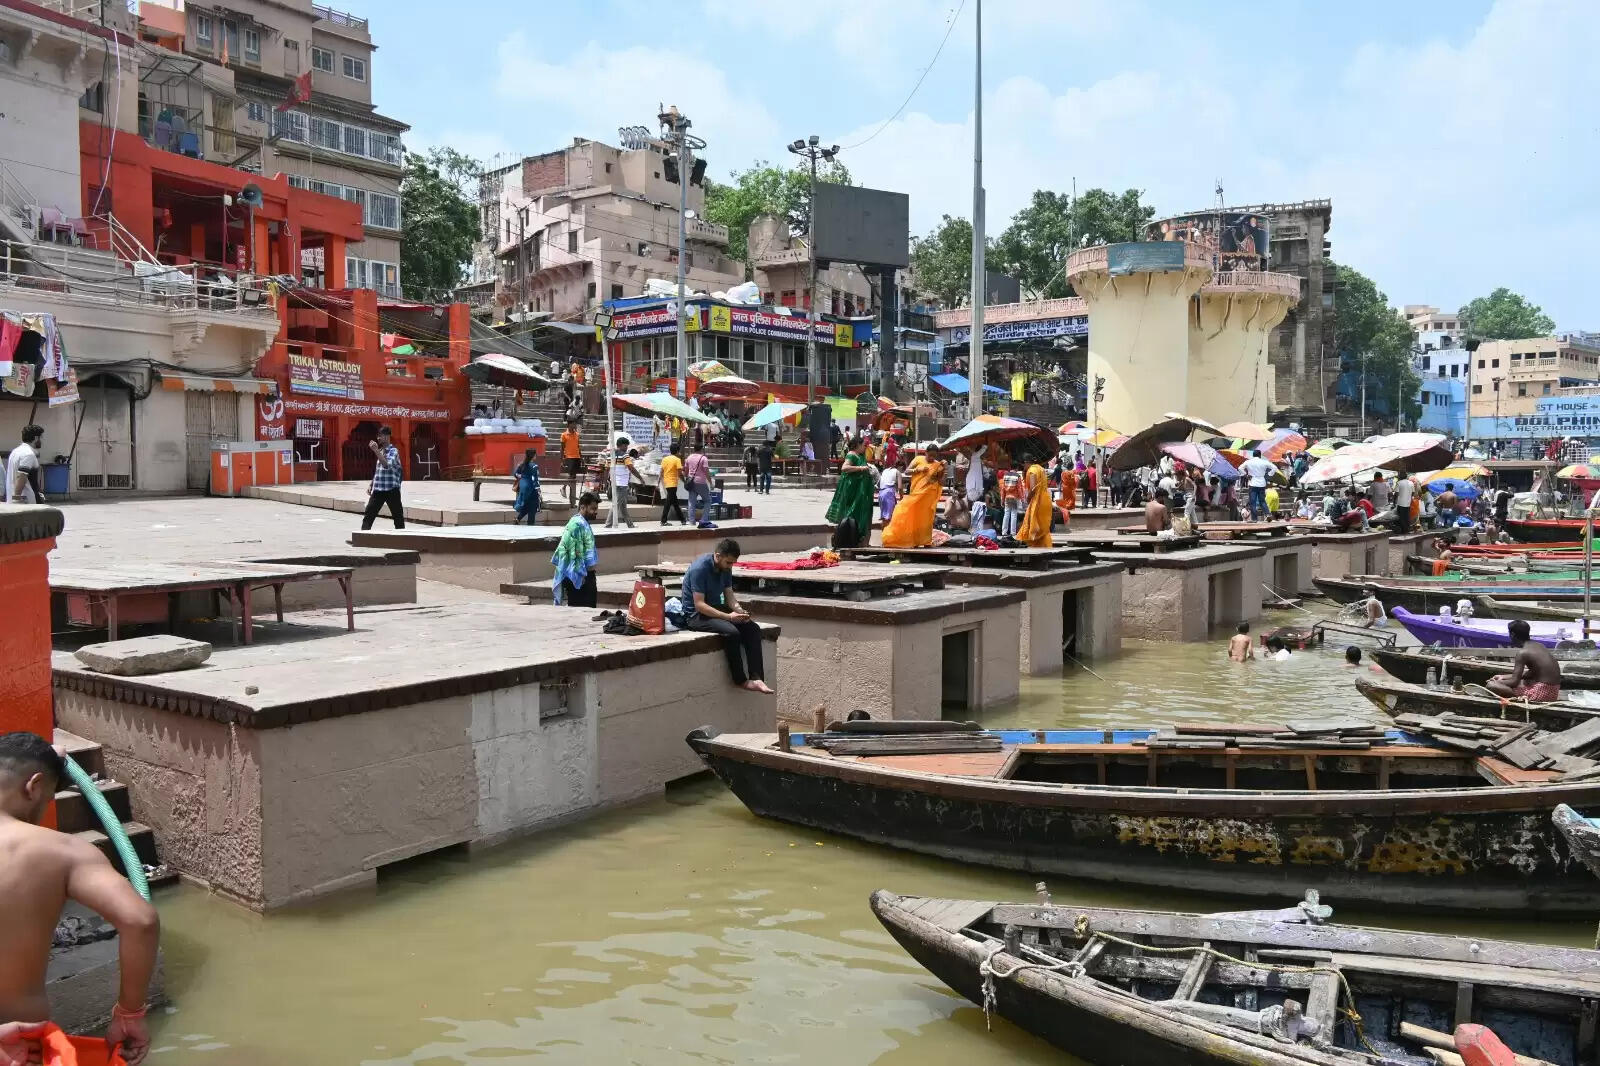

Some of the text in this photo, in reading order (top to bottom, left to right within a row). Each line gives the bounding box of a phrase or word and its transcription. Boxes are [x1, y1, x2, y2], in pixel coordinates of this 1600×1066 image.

[731, 311, 749, 323] जल
[749, 311, 771, 328] पुलिस
[732, 325, 748, 333] RIVER
[749, 327, 767, 335] POLICE
[289, 353, 317, 369] TRIKAL
[319, 358, 361, 375] ASTROLOGY
[1556, 402, 1588, 411] HOUSE
